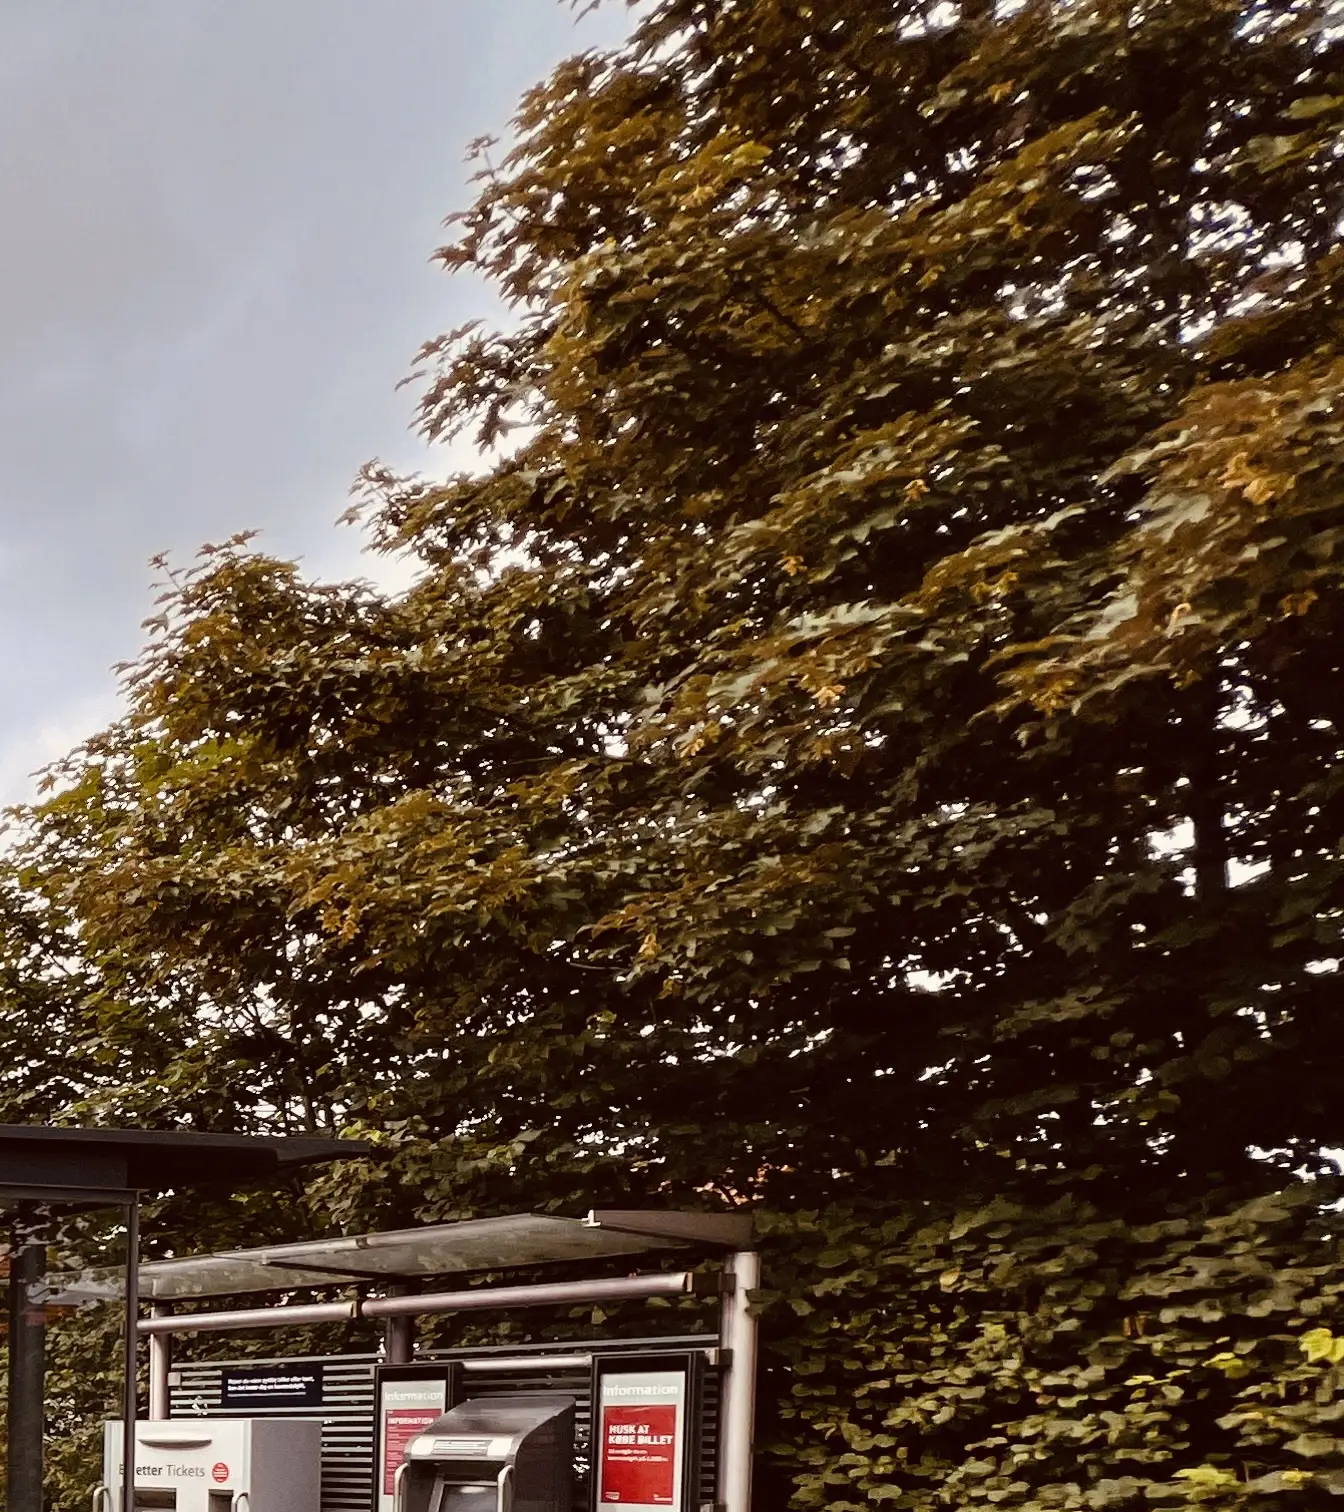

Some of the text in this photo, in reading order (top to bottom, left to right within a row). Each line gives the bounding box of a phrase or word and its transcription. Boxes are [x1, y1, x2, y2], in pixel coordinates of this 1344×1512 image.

[603, 1384, 678, 1396] Information
[608, 1424, 650, 1434] HUSK AT
[608, 1435, 673, 1444] KØBE BILLET
[119, 1463, 163, 1476] Better
[166, 1464, 205, 1477] Tickets
